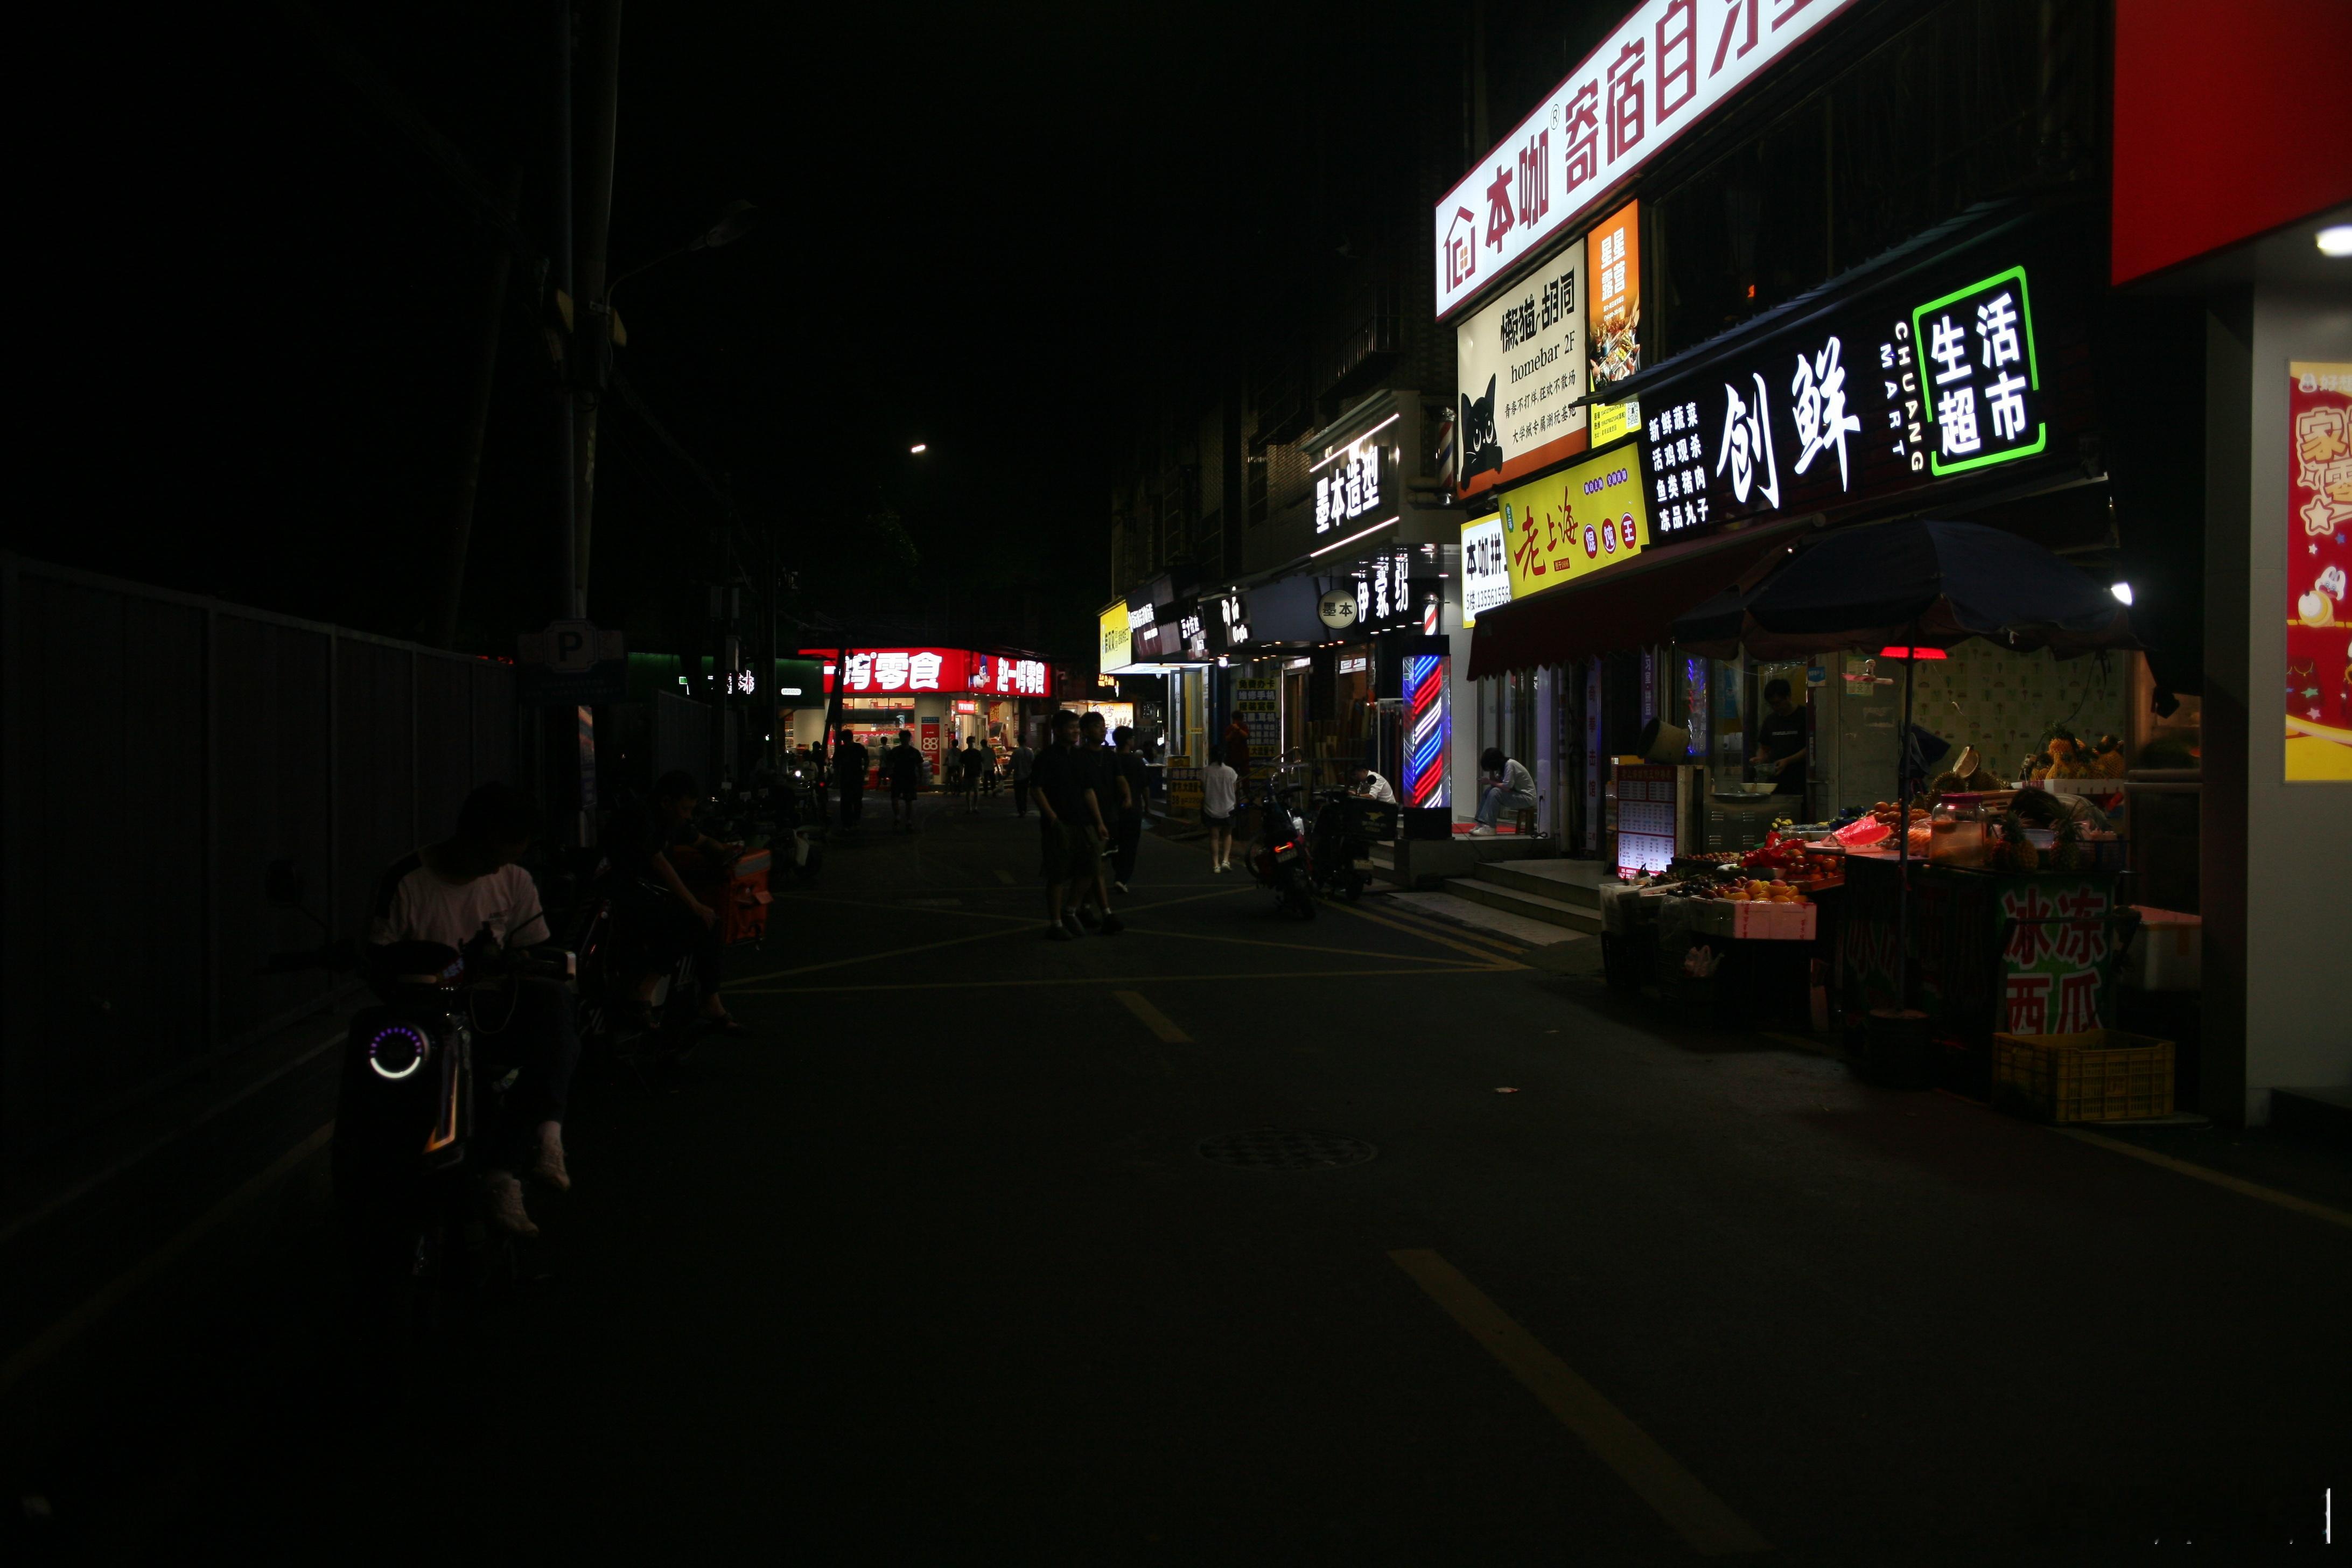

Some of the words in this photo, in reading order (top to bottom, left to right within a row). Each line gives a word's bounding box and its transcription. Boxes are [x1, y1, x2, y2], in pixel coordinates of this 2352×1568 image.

[1511, 344, 1559, 384] homebar
[1564, 330, 1575, 354] 2F
[1930, 292, 2020, 385] 生活
[1649, 402, 1699, 443] 新鲜蔬菜
[1716, 336, 1861, 509] 创鲜
[1881, 344, 1905, 456] MART
[1895, 321, 1924, 472] CHUANG
[1939, 370, 2026, 457] 超市
[1652, 434, 1702, 471] 活鸡现杀
[2297, 408, 2352, 464] 家
[1315, 446, 1380, 534] 墨本造型
[1656, 465, 1706, 503] 鱼类猪肉
[1514, 486, 1578, 581] 老上海
[1584, 519, 1635, 554] 馄饨王
[1659, 498, 1709, 533] 冻品丸子
[1322, 602, 1353, 617] 墨本
[558, 632, 583, 661] P
[997, 657, 1045, 694] 赵一鸣零食
[1239, 680, 1275, 689] 免费办卡
[2002, 885, 2106, 967] 冰冻
[2006, 971, 2100, 1035] 西瓜
